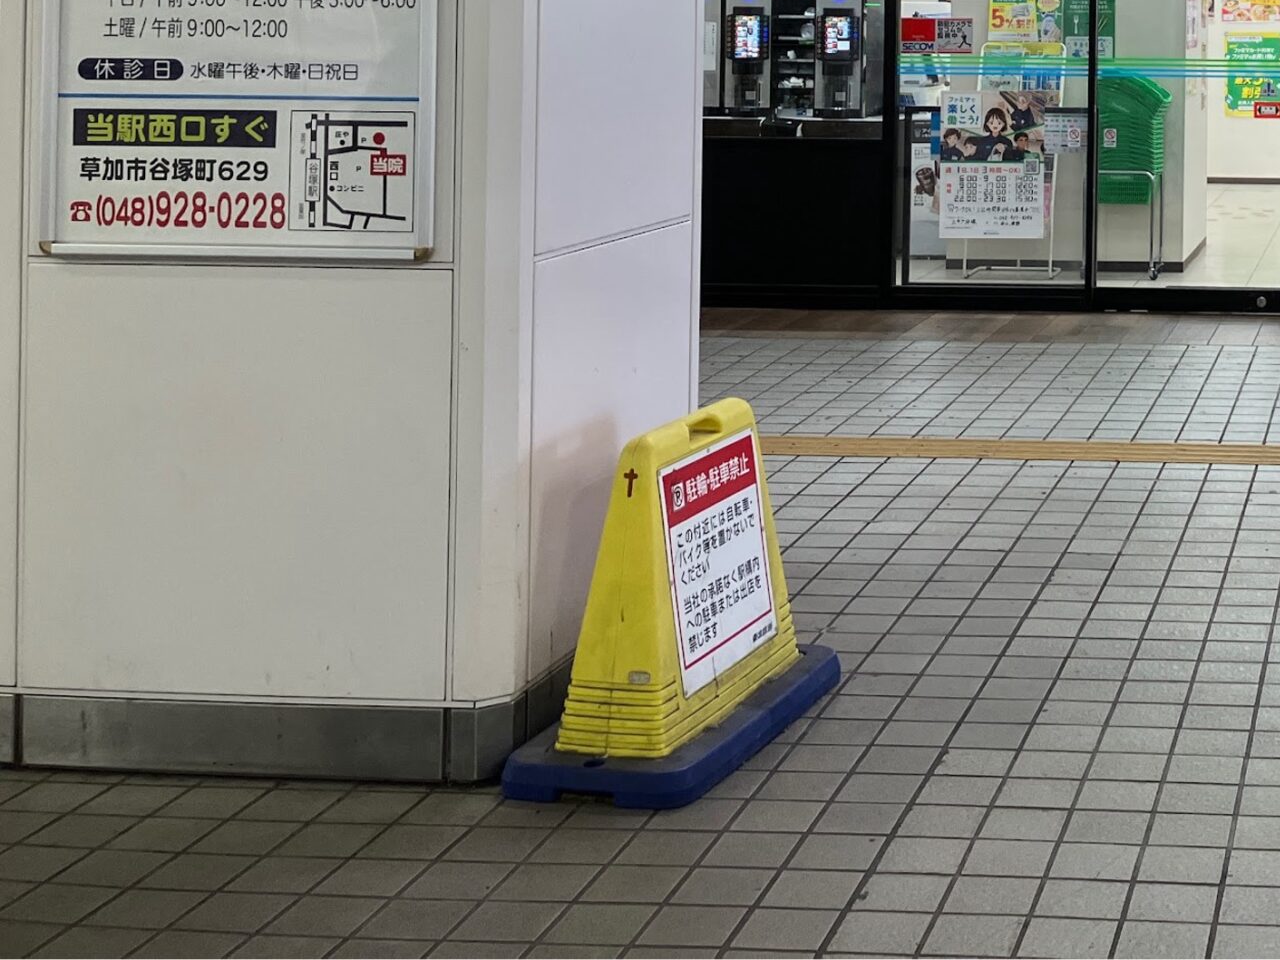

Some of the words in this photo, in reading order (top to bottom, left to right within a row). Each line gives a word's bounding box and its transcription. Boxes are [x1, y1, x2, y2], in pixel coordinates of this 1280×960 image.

[902, 43, 935, 52] SECOM
[94, 60, 172, 80] 休診日
[947, 104, 977, 115] 楽しく
[86, 112, 270, 145] 当駅西口すぐ
[80, 157, 268, 182] 草加市谷塚町629
[372, 157, 405, 174] 当院
[685, 452, 750, 503] 駐輪・駐車禁止
[678, 516, 756, 568] バイク等を置かないで
[680, 557, 711, 585] ください
[683, 556, 761, 615] 当社の承諾なく駅構内
[688, 622, 719, 653] 禁じます
